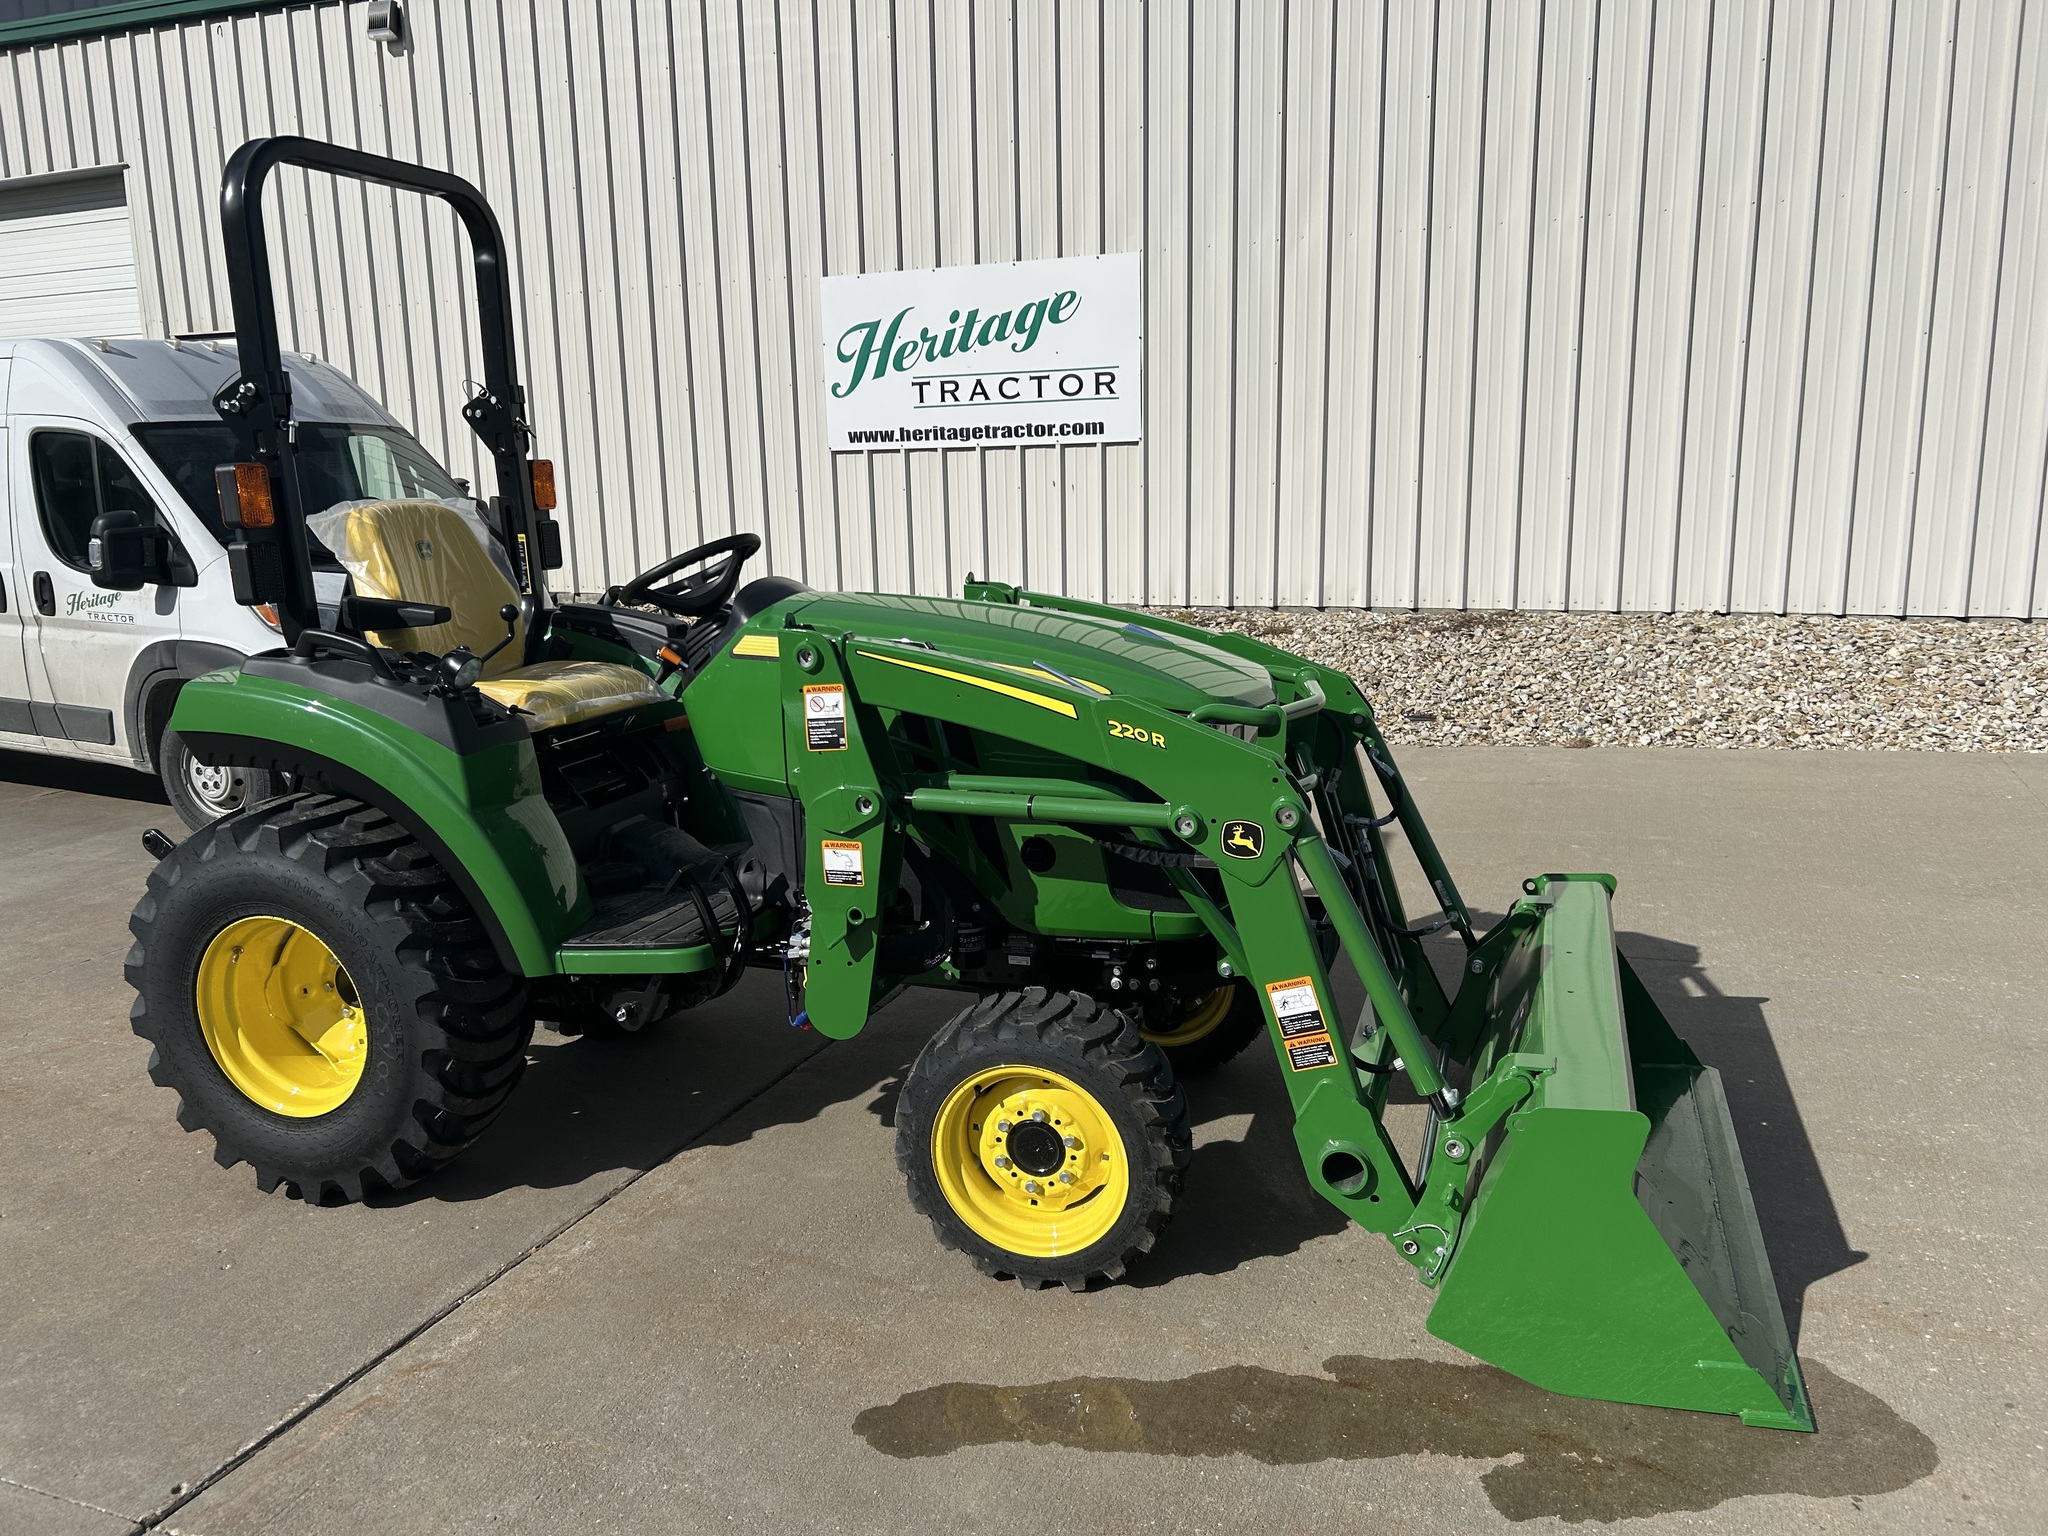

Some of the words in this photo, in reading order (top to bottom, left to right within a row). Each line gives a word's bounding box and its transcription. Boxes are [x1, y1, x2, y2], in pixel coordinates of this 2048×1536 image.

[831, 290, 1082, 398] Heritage
[911, 371, 1118, 404] TRACTOR
[848, 420, 1105, 444] www.heritagetractor.com
[66, 591, 122, 616] Heritage
[87, 612, 135, 624] TRACTOR
[1278, 979, 1307, 990] WARNING
[1297, 1036, 1326, 1047] WARNING
